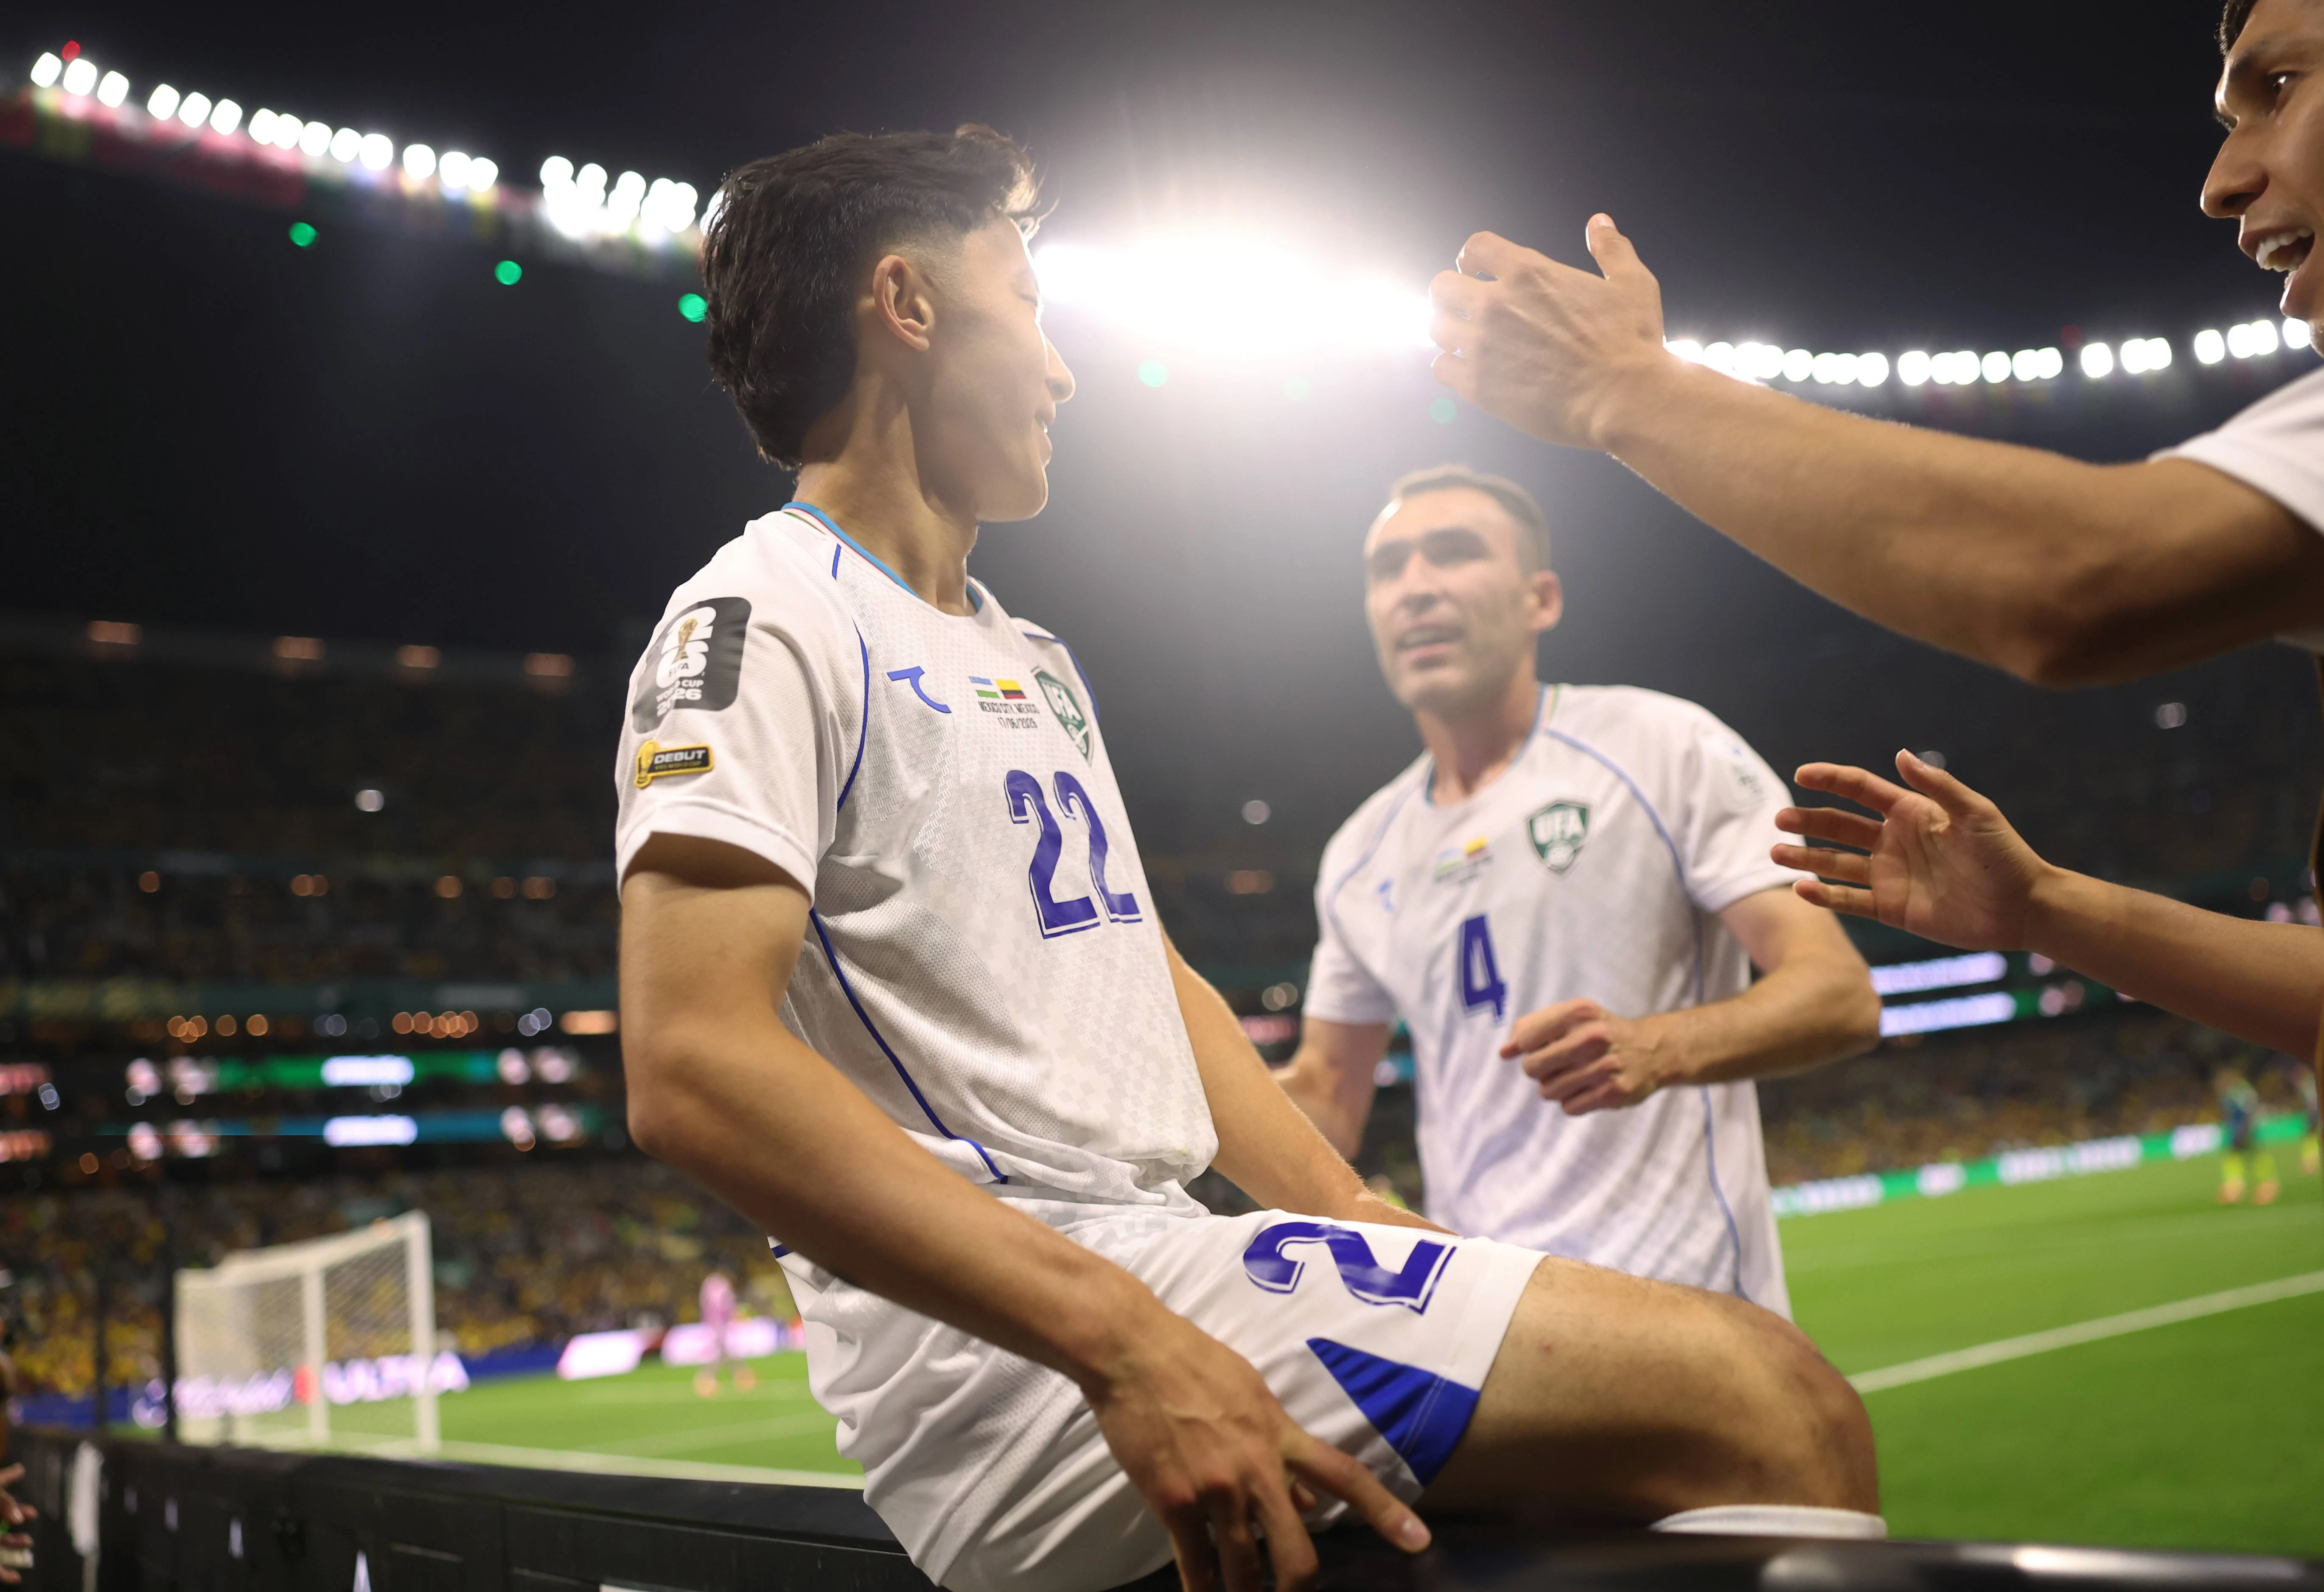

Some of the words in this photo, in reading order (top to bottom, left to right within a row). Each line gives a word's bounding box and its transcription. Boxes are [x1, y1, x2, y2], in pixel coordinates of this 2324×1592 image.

[669, 663, 689, 677] FIFA
[681, 679, 704, 688] CUP
[978, 701, 1002, 713] MEXICO
[1014, 703, 1040, 714] MEXICO
[998, 717, 1038, 729] 17/06/2026
[654, 749, 706, 764] DEBUT
[1004, 769, 1143, 939] 22
[1457, 914, 1507, 1028] 4
